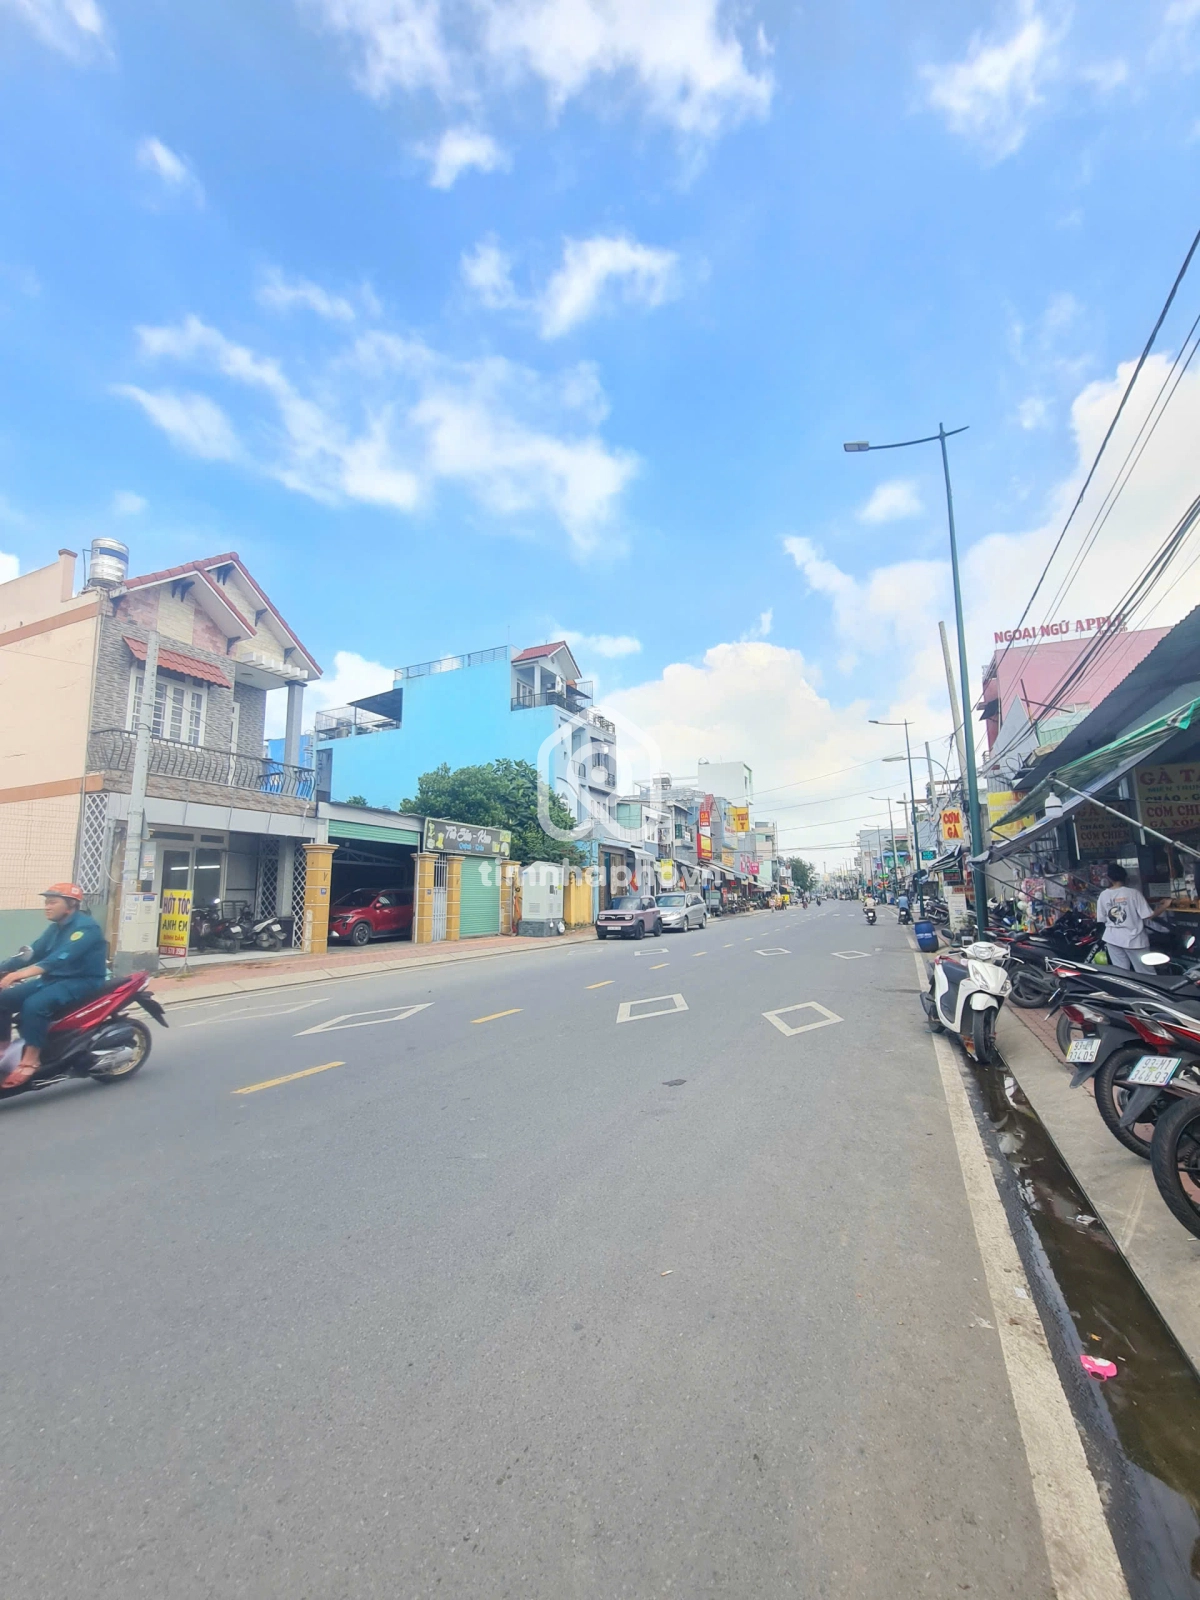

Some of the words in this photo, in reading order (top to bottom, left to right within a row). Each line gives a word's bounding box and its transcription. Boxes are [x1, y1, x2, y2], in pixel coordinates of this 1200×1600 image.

[943, 812, 960, 824] CƠM
[947, 825, 959, 838] GÀ
[178, 893, 190, 915] TÓC
